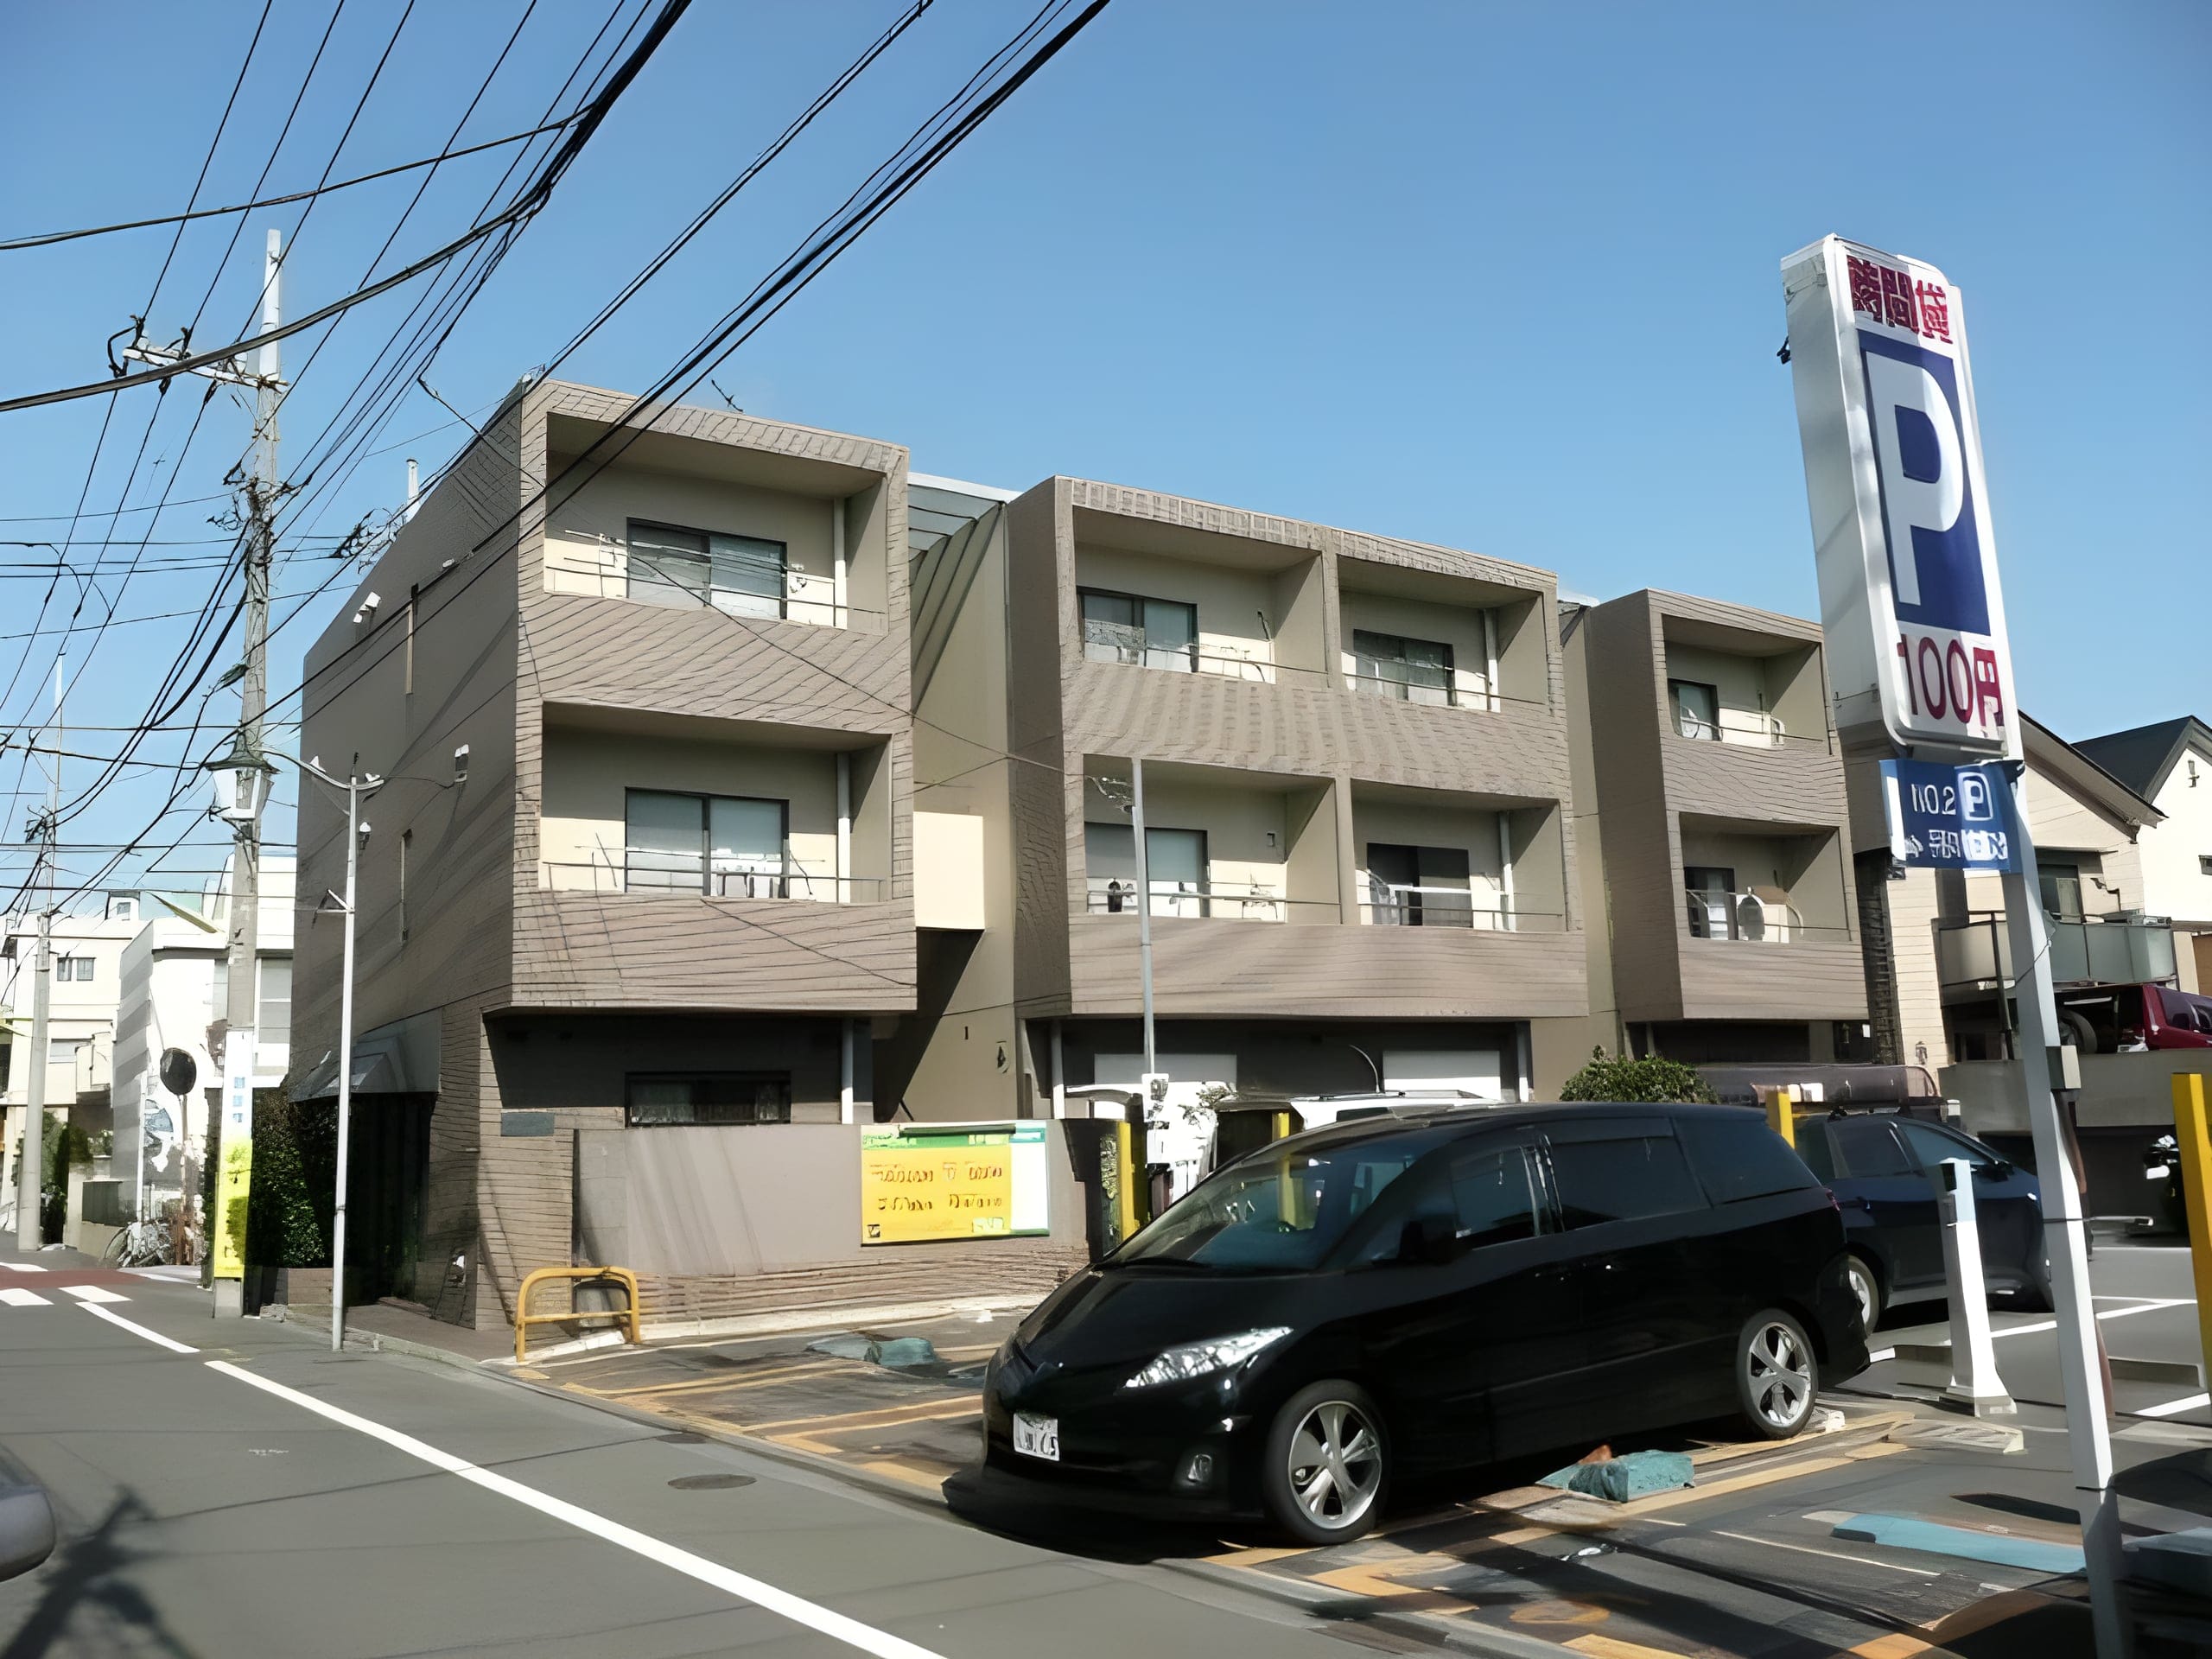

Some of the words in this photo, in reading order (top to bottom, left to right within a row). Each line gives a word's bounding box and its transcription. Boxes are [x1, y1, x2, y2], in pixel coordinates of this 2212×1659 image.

[1866, 351, 1963, 606] P
[1897, 633, 2005, 731] 100円
[1961, 778, 1986, 815] P
